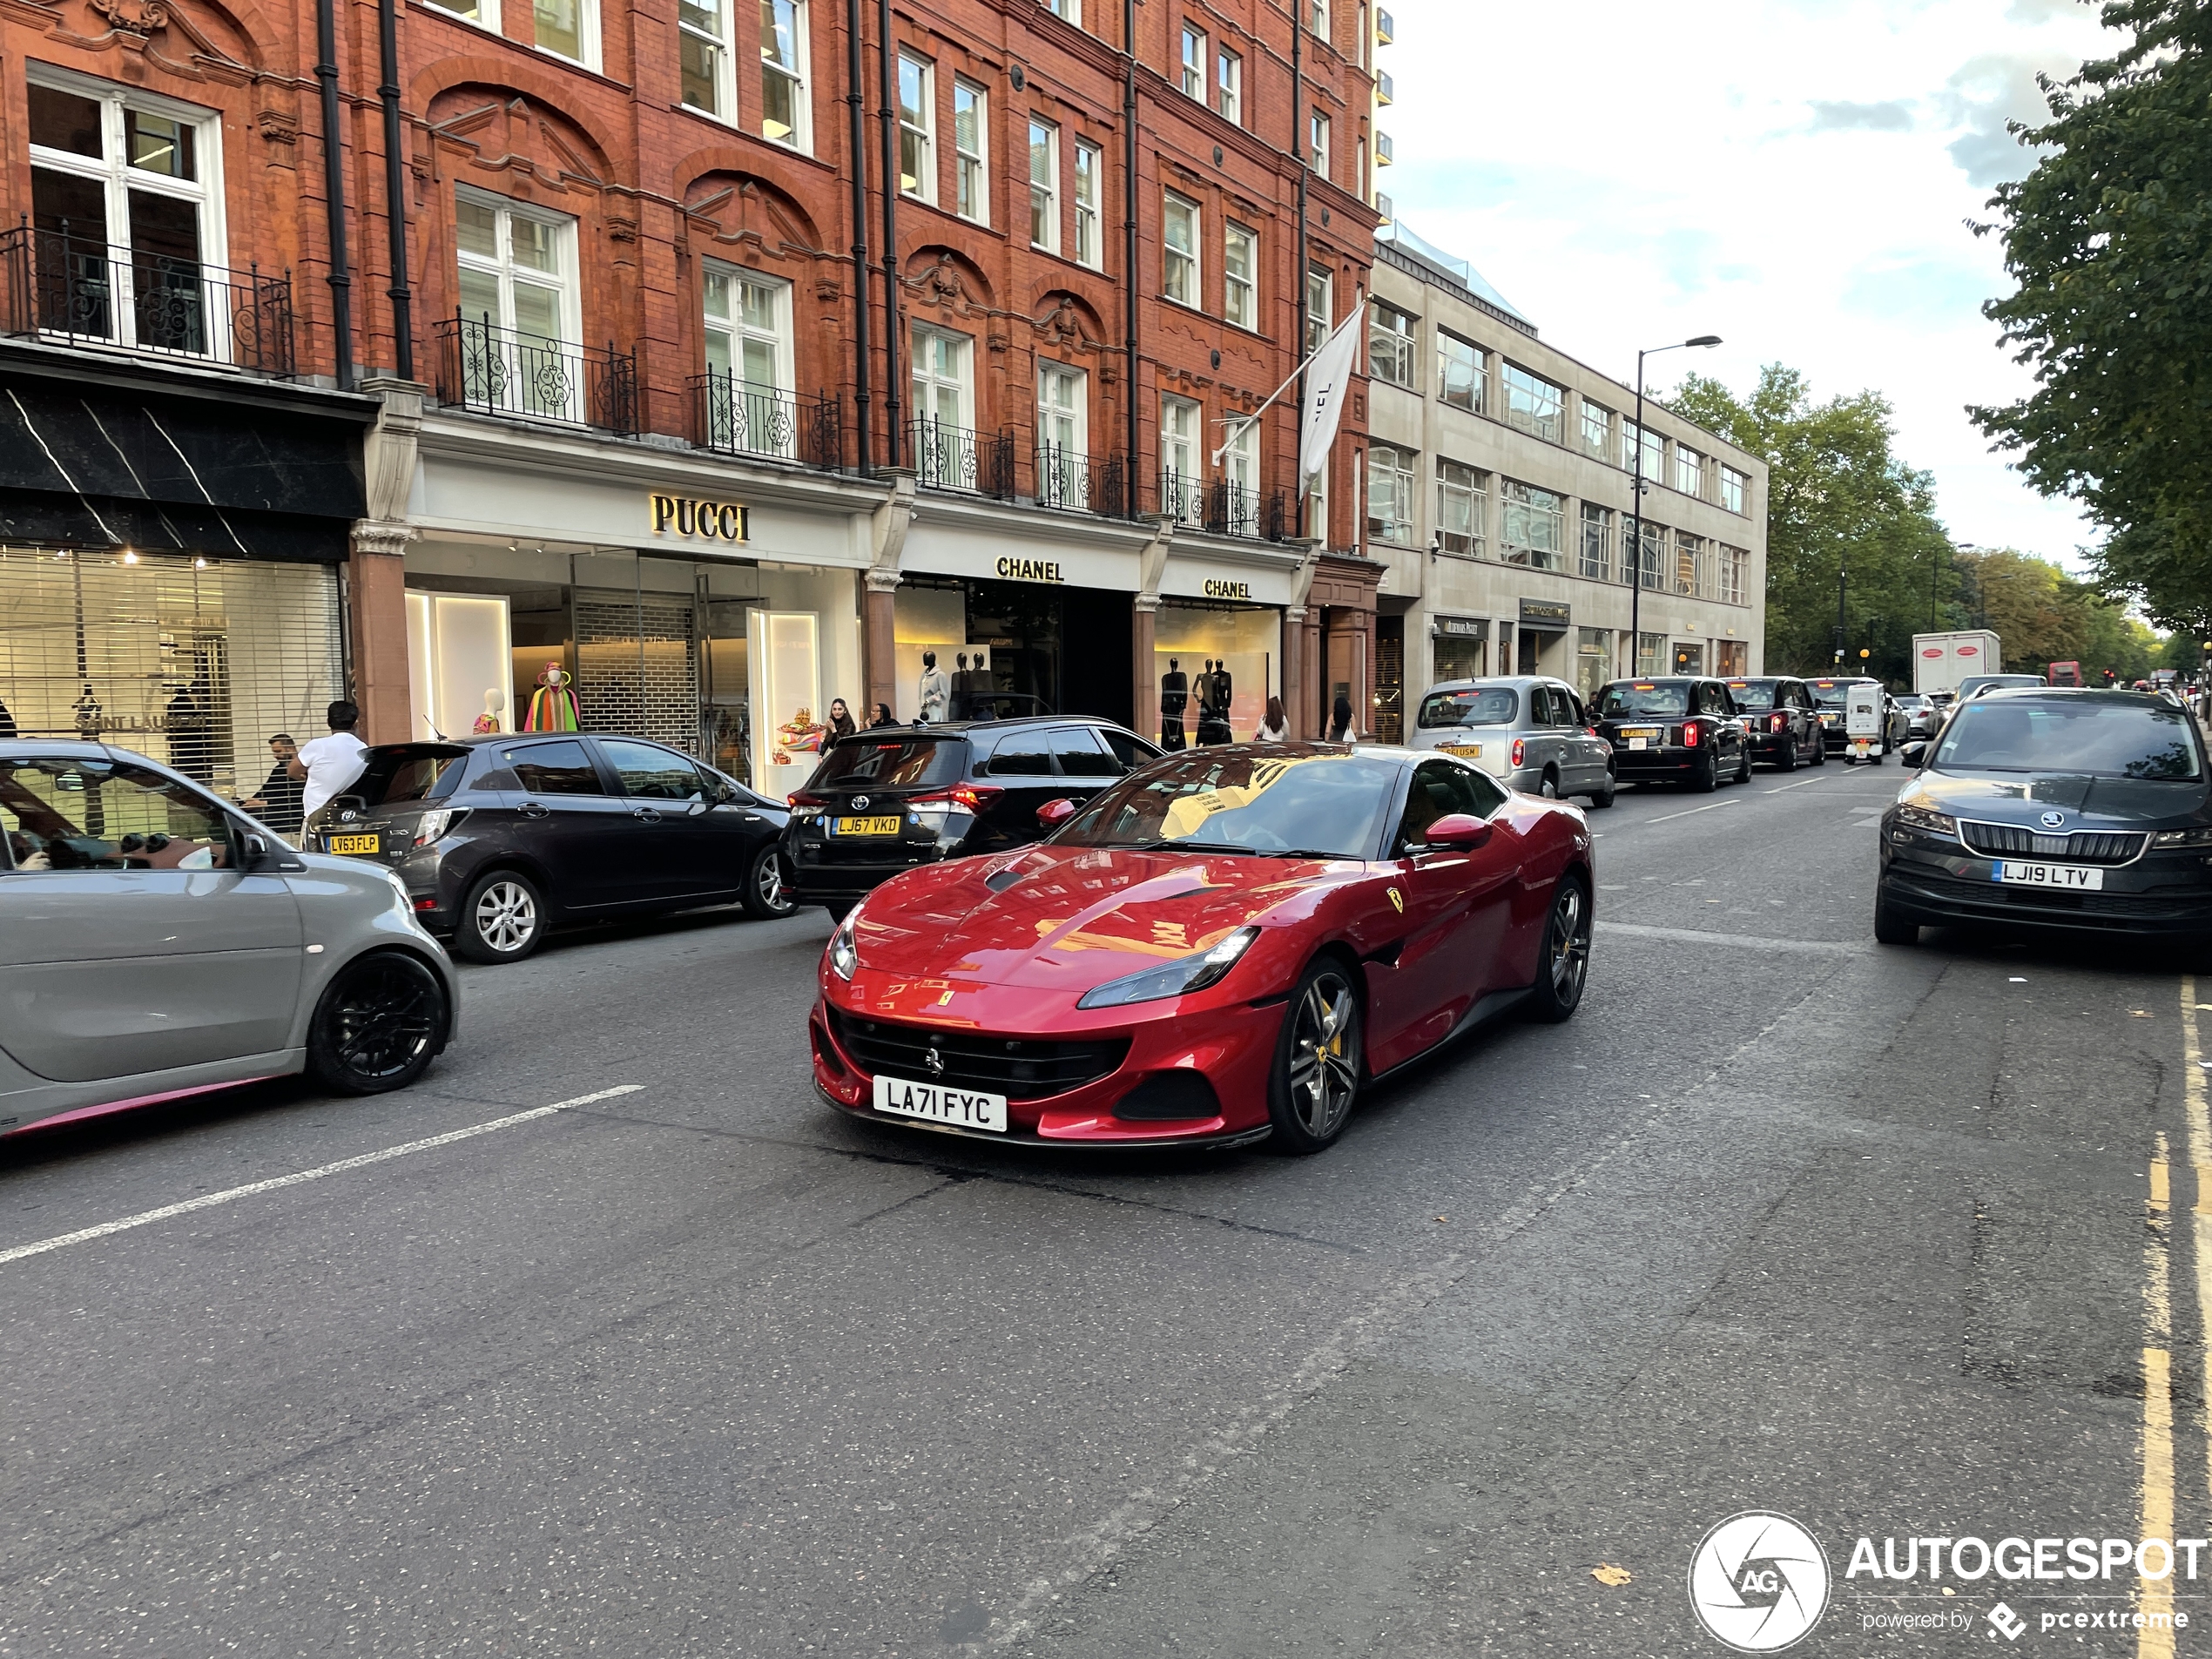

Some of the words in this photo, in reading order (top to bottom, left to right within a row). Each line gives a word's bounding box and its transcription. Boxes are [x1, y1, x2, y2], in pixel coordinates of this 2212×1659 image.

[651, 495, 751, 542] PUCCI
[995, 556, 1065, 582] CHANEL
[1204, 578, 1252, 599] CHANEL
[74, 715, 126, 730] SAINT
[130, 714, 210, 729] LAURENT
[839, 819, 870, 832] LJ67
[873, 818, 897, 832] VKD
[332, 837, 354, 851] LV63
[356, 837, 375, 850] FLP
[2004, 864, 2046, 881] LJ19
[2051, 867, 2088, 885] LTV
[887, 1082, 937, 1116] LA71
[944, 1091, 990, 1123] FYC
